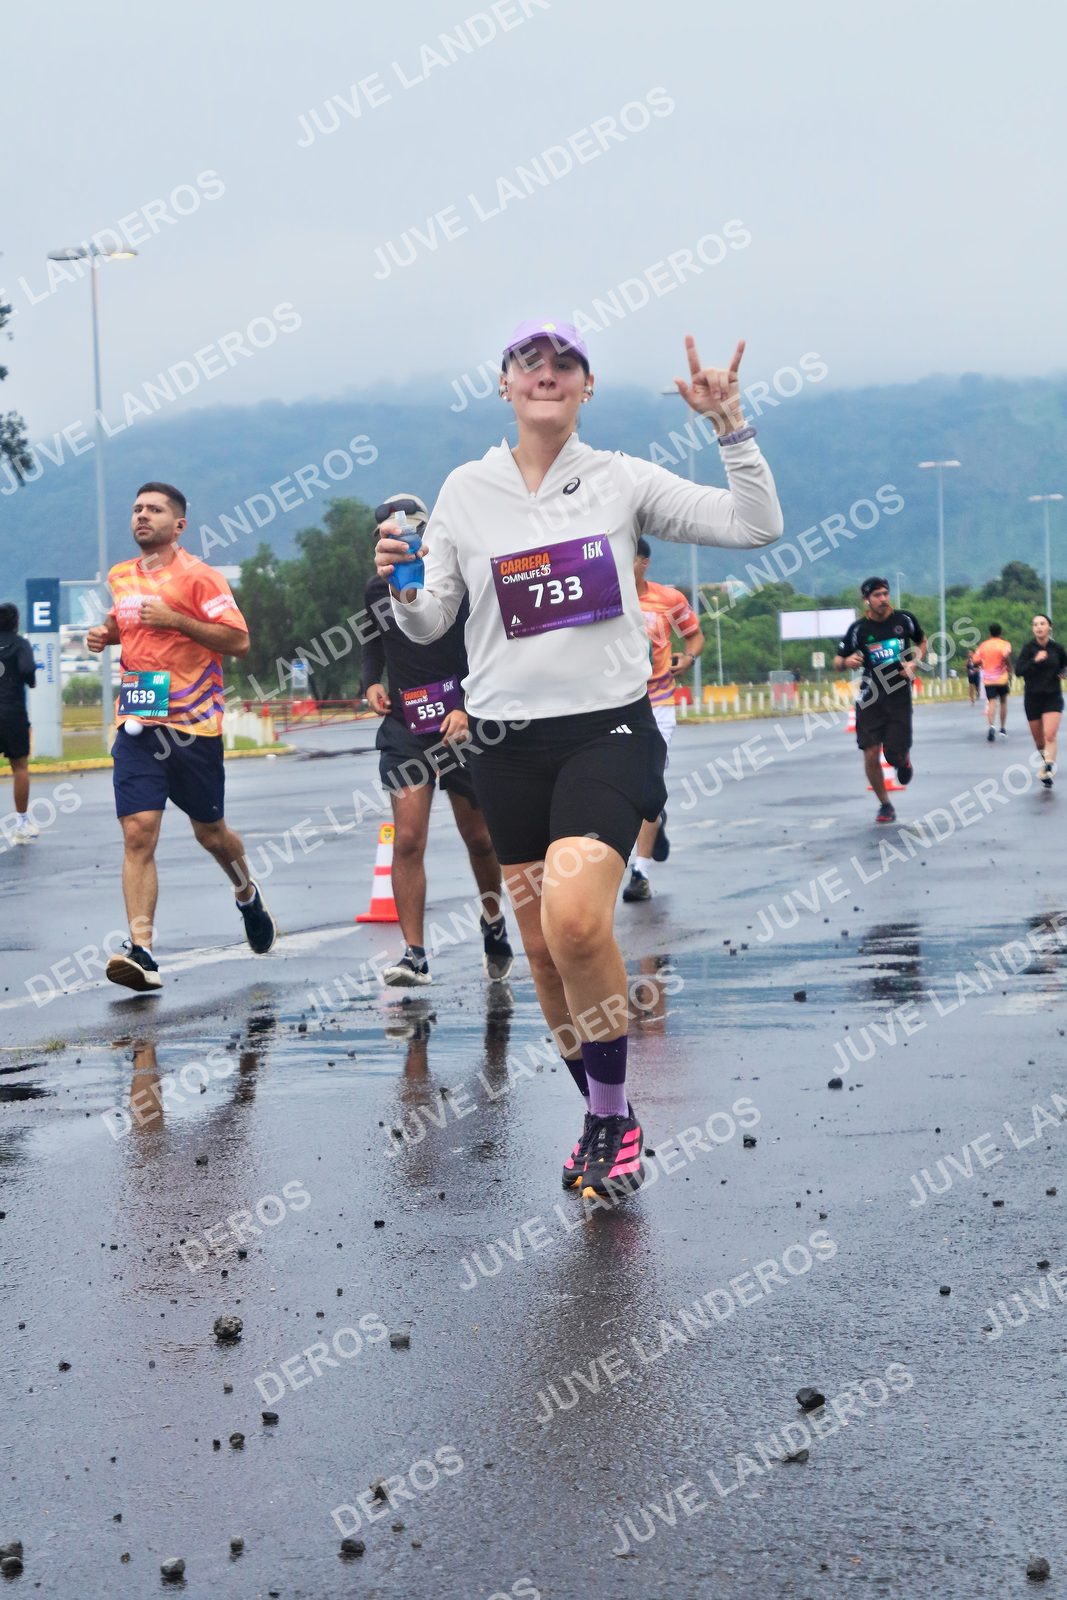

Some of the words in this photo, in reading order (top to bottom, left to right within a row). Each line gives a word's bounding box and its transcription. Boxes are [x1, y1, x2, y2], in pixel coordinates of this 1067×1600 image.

[500, 552, 551, 575] CARRERA
[528, 576, 583, 608] 733
[33, 601, 51, 626] E
[126, 689, 156, 704] 1639
[417, 701, 445, 720] 553
